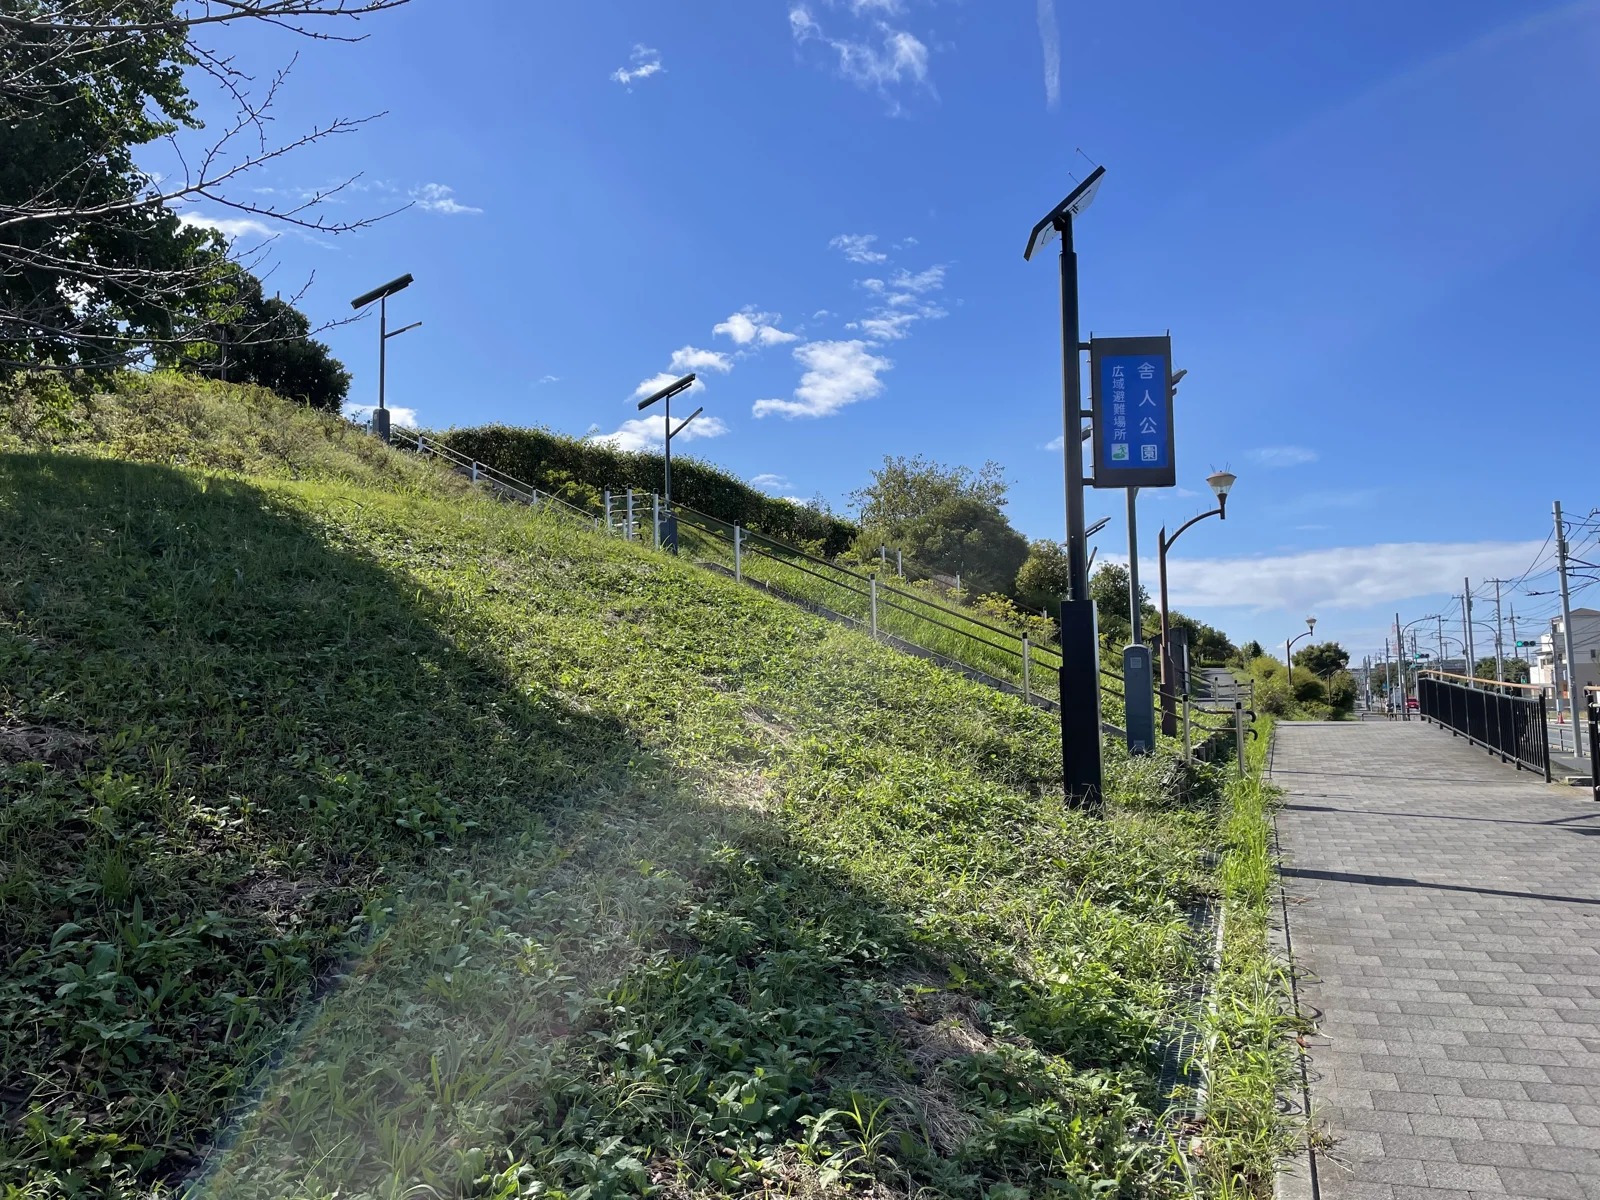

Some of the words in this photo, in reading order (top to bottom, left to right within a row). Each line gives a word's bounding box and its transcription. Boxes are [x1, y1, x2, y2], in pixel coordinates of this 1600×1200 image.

[1111, 365, 1127, 440] 広域避難場所
[1137, 362, 1158, 461] 舎人公園
